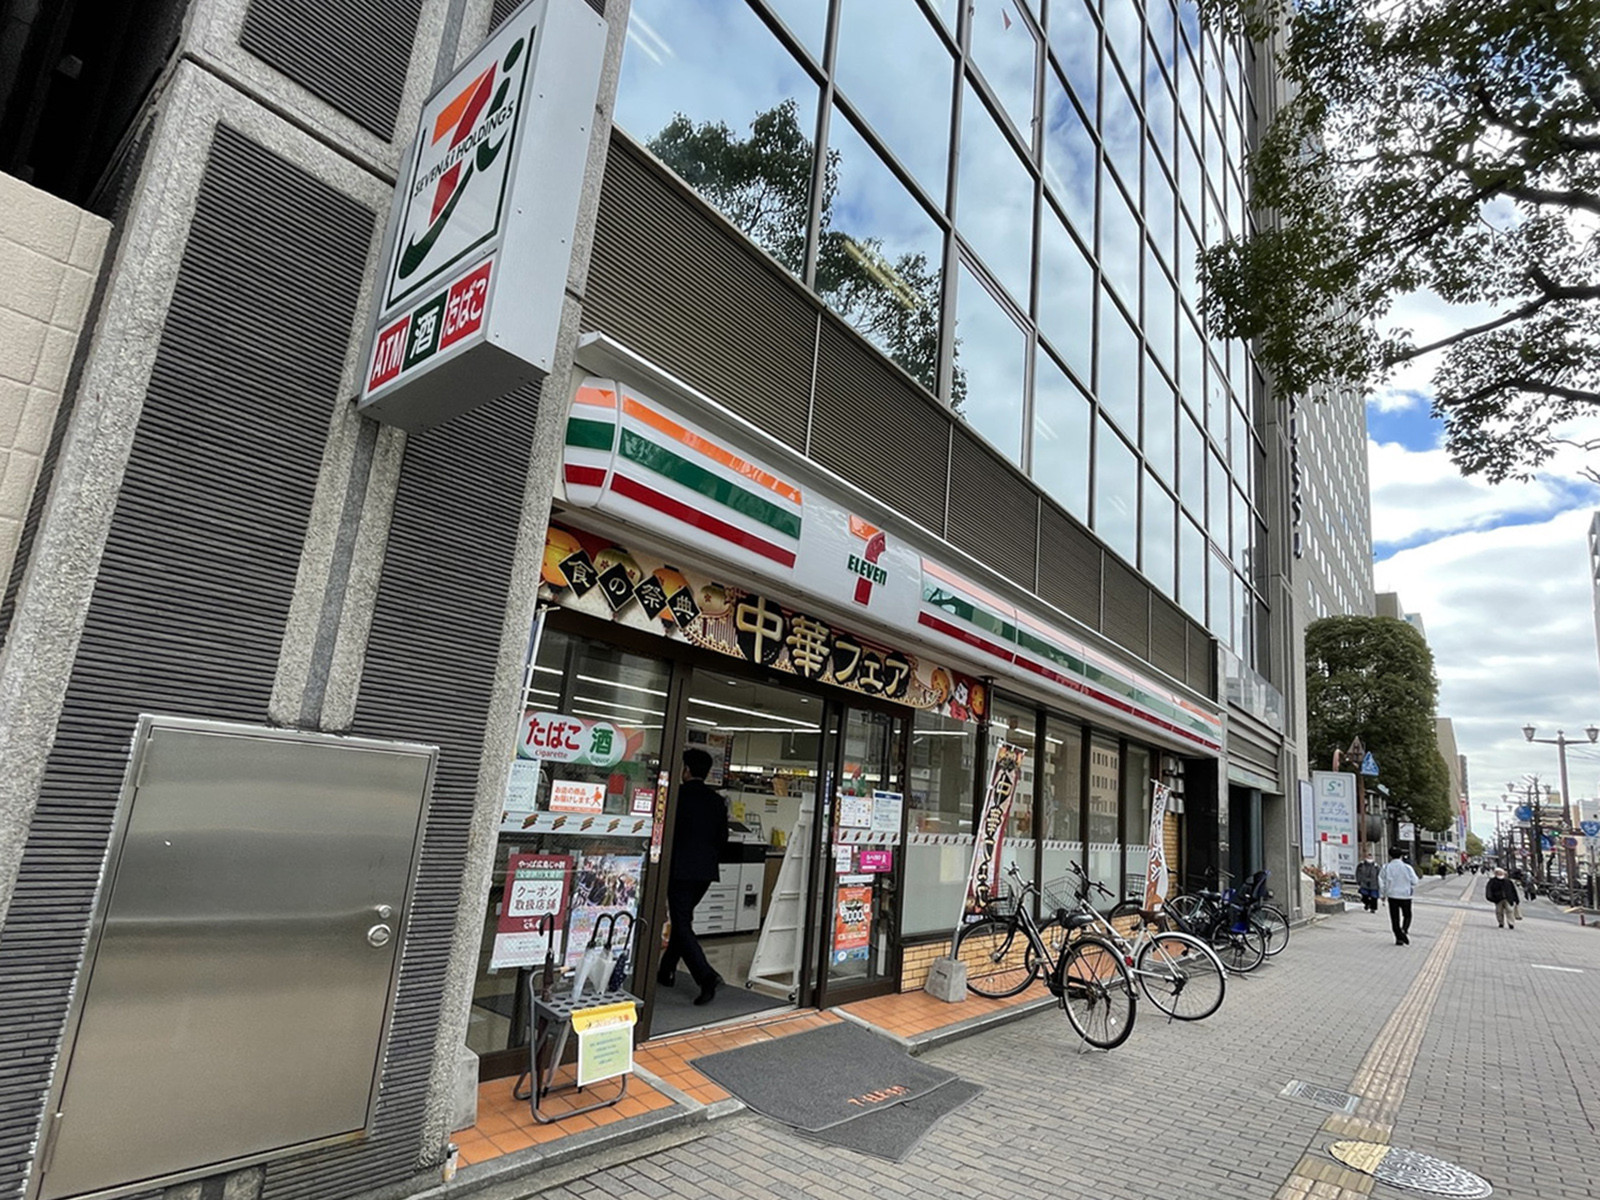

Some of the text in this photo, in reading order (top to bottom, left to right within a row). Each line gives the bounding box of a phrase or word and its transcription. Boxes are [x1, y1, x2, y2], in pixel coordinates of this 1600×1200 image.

[456, 100, 514, 161] HOLDINGS
[371, 277, 487, 382] ATM 酒 たばこ
[566, 559, 695, 620] 食の祭典
[736, 595, 909, 696] 中華フェア
[526, 718, 614, 756] たばこ 酒
[514, 899, 557, 911] 取扱店舗
[516, 886, 559, 898] クーポン
